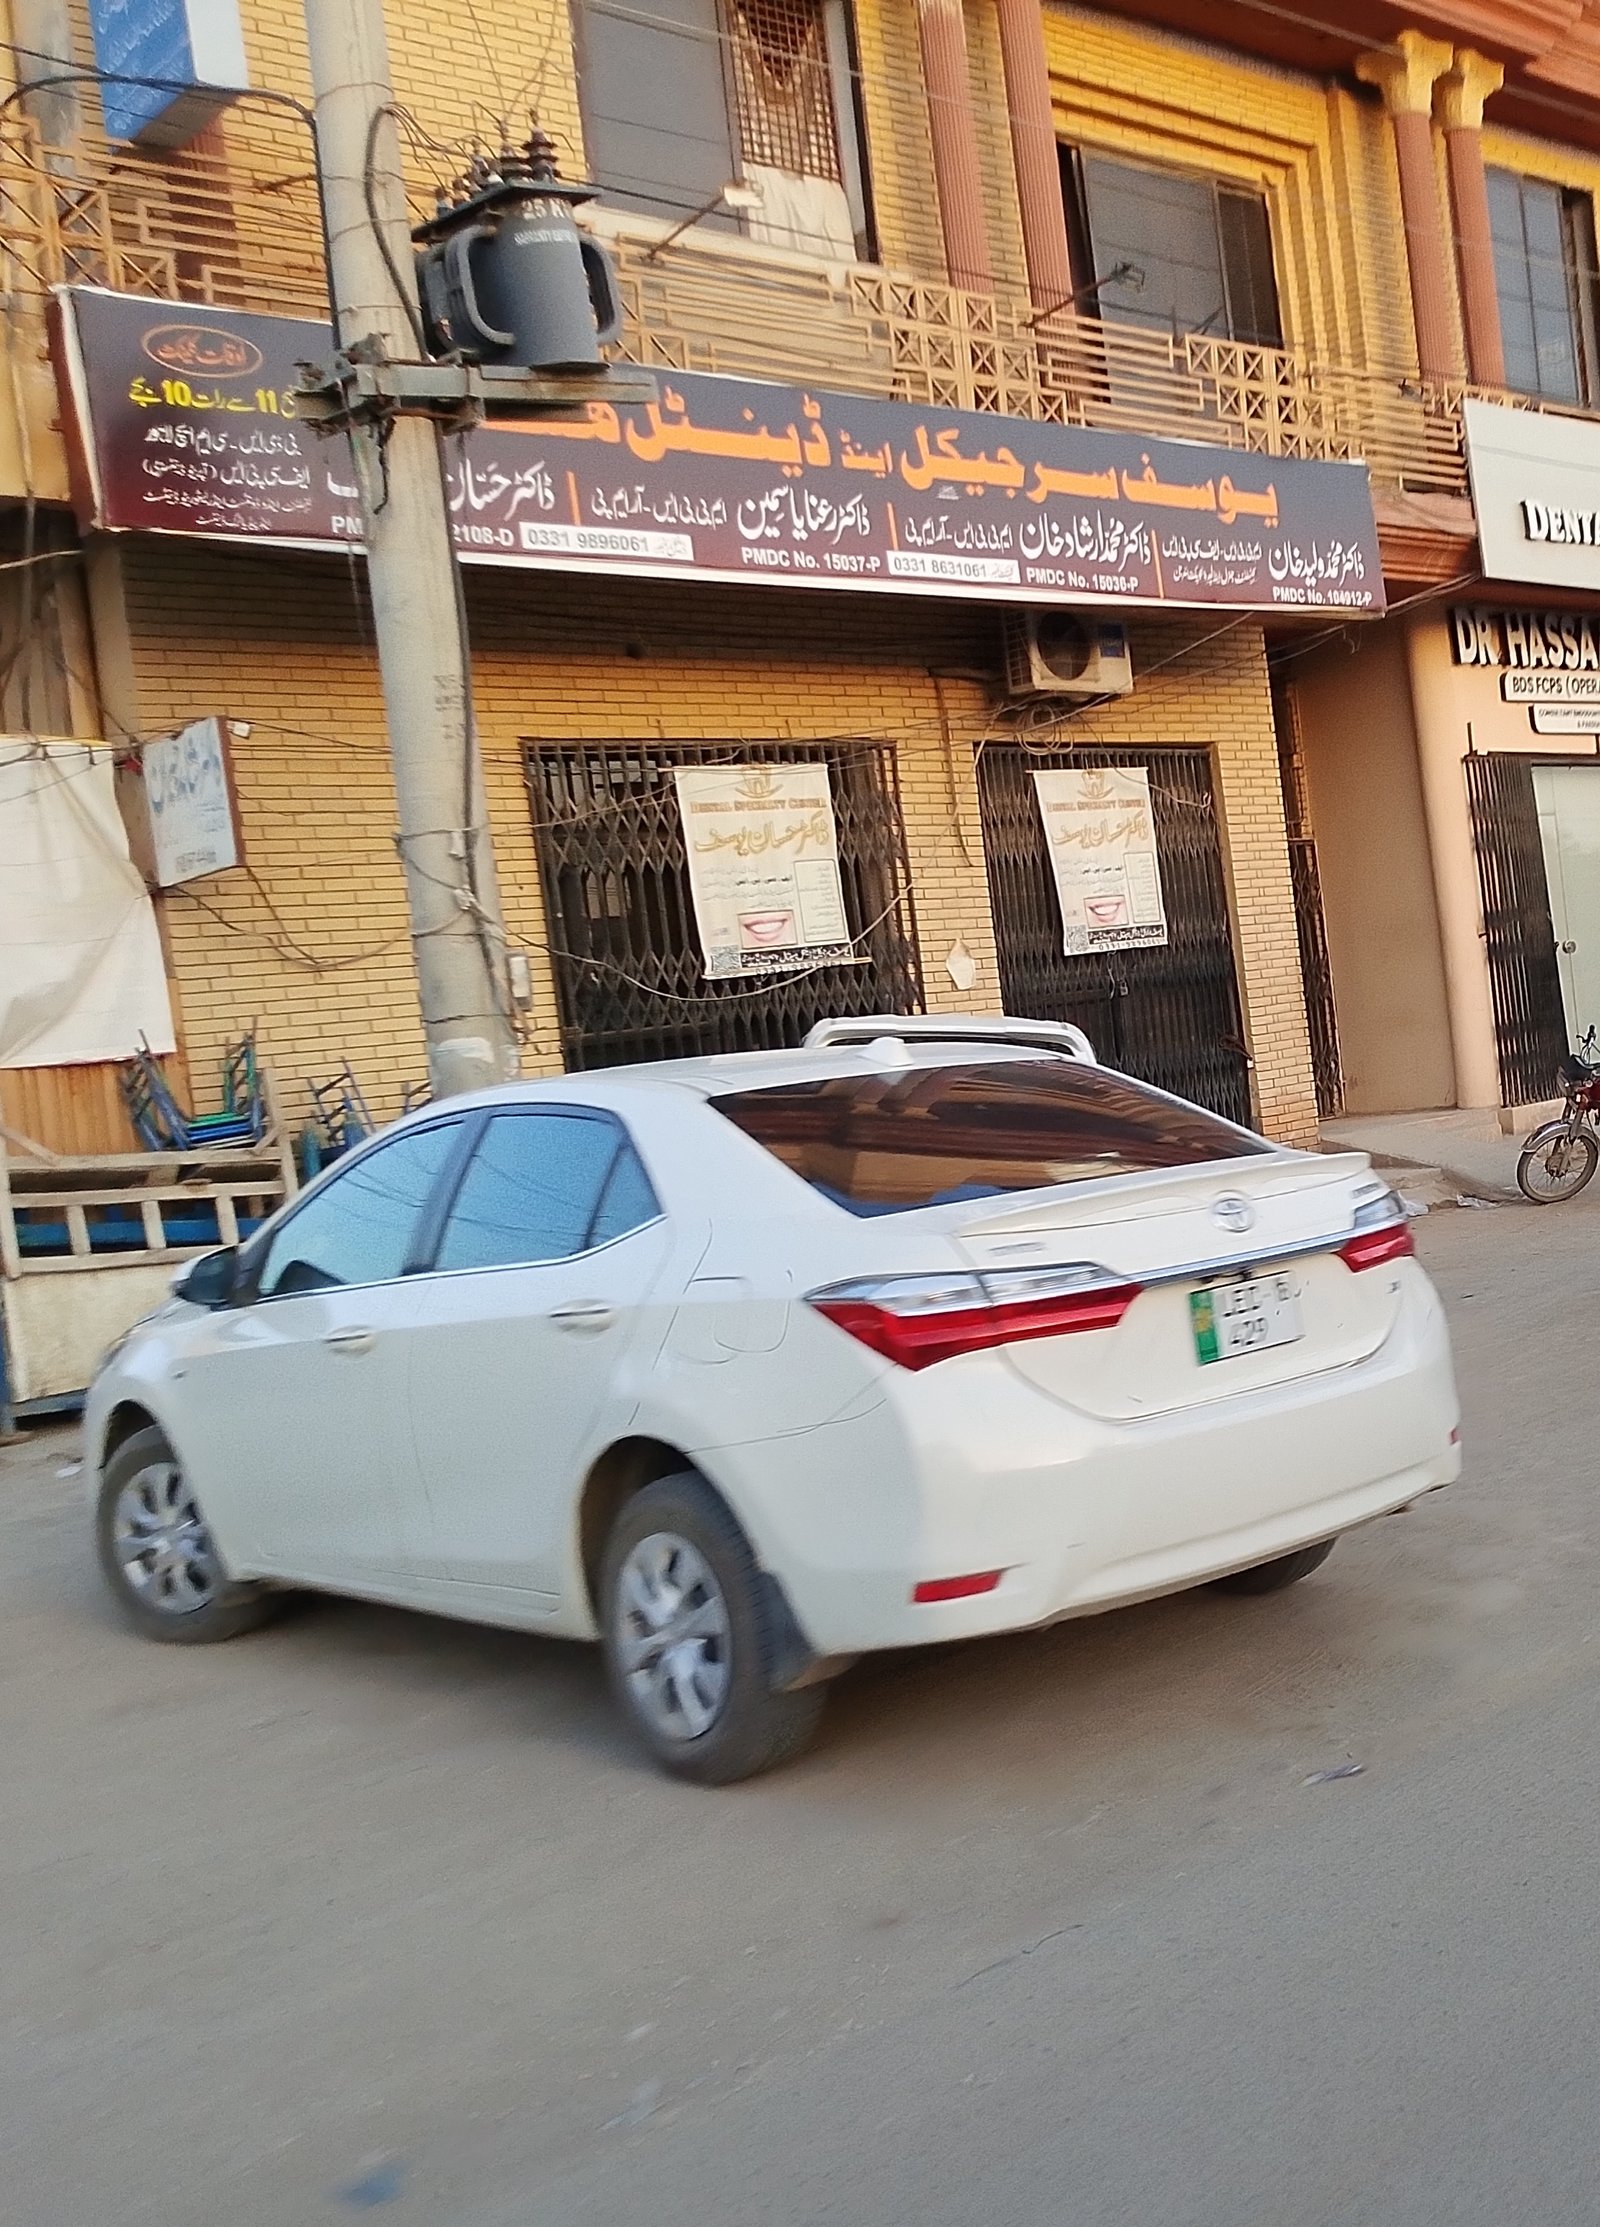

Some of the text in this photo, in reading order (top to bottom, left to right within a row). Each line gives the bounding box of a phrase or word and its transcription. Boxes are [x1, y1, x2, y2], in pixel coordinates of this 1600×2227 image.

[161, 378, 192, 408] 10
[255, 387, 279, 415] 11
[625, 385, 832, 479] ڈینٹل
[839, 428, 893, 479] اینڈ
[901, 424, 1120, 505] سرجیکل
[503, 459, 555, 522] ڈاکٹر
[737, 484, 809, 541] یاسمین
[1122, 452, 1280, 529] یوسف
[451, 523, 515, 547] 2108-D
[527, 528, 571, 547] 0331
[576, 532, 650, 552] 9896061
[831, 493, 871, 545] ڈاکٹر
[1019, 512, 1065, 560] خان
[741, 546, 881, 573] PMDC No. 15037-P
[893, 556, 926, 573] 0331
[930, 559, 987, 578] 8631061
[1117, 519, 1151, 572] ڈاکٹر
[1268, 539, 1304, 581] خان
[1338, 541, 1366, 588] ڈاکٹر
[1026, 566, 1066, 586] PMDC
[1067, 570, 1090, 589] No.
[1272, 585, 1306, 604] PMDC
[1503, 609, 1600, 671] HASSA
[1512, 675, 1600, 699] BDS FCPS (OPER
